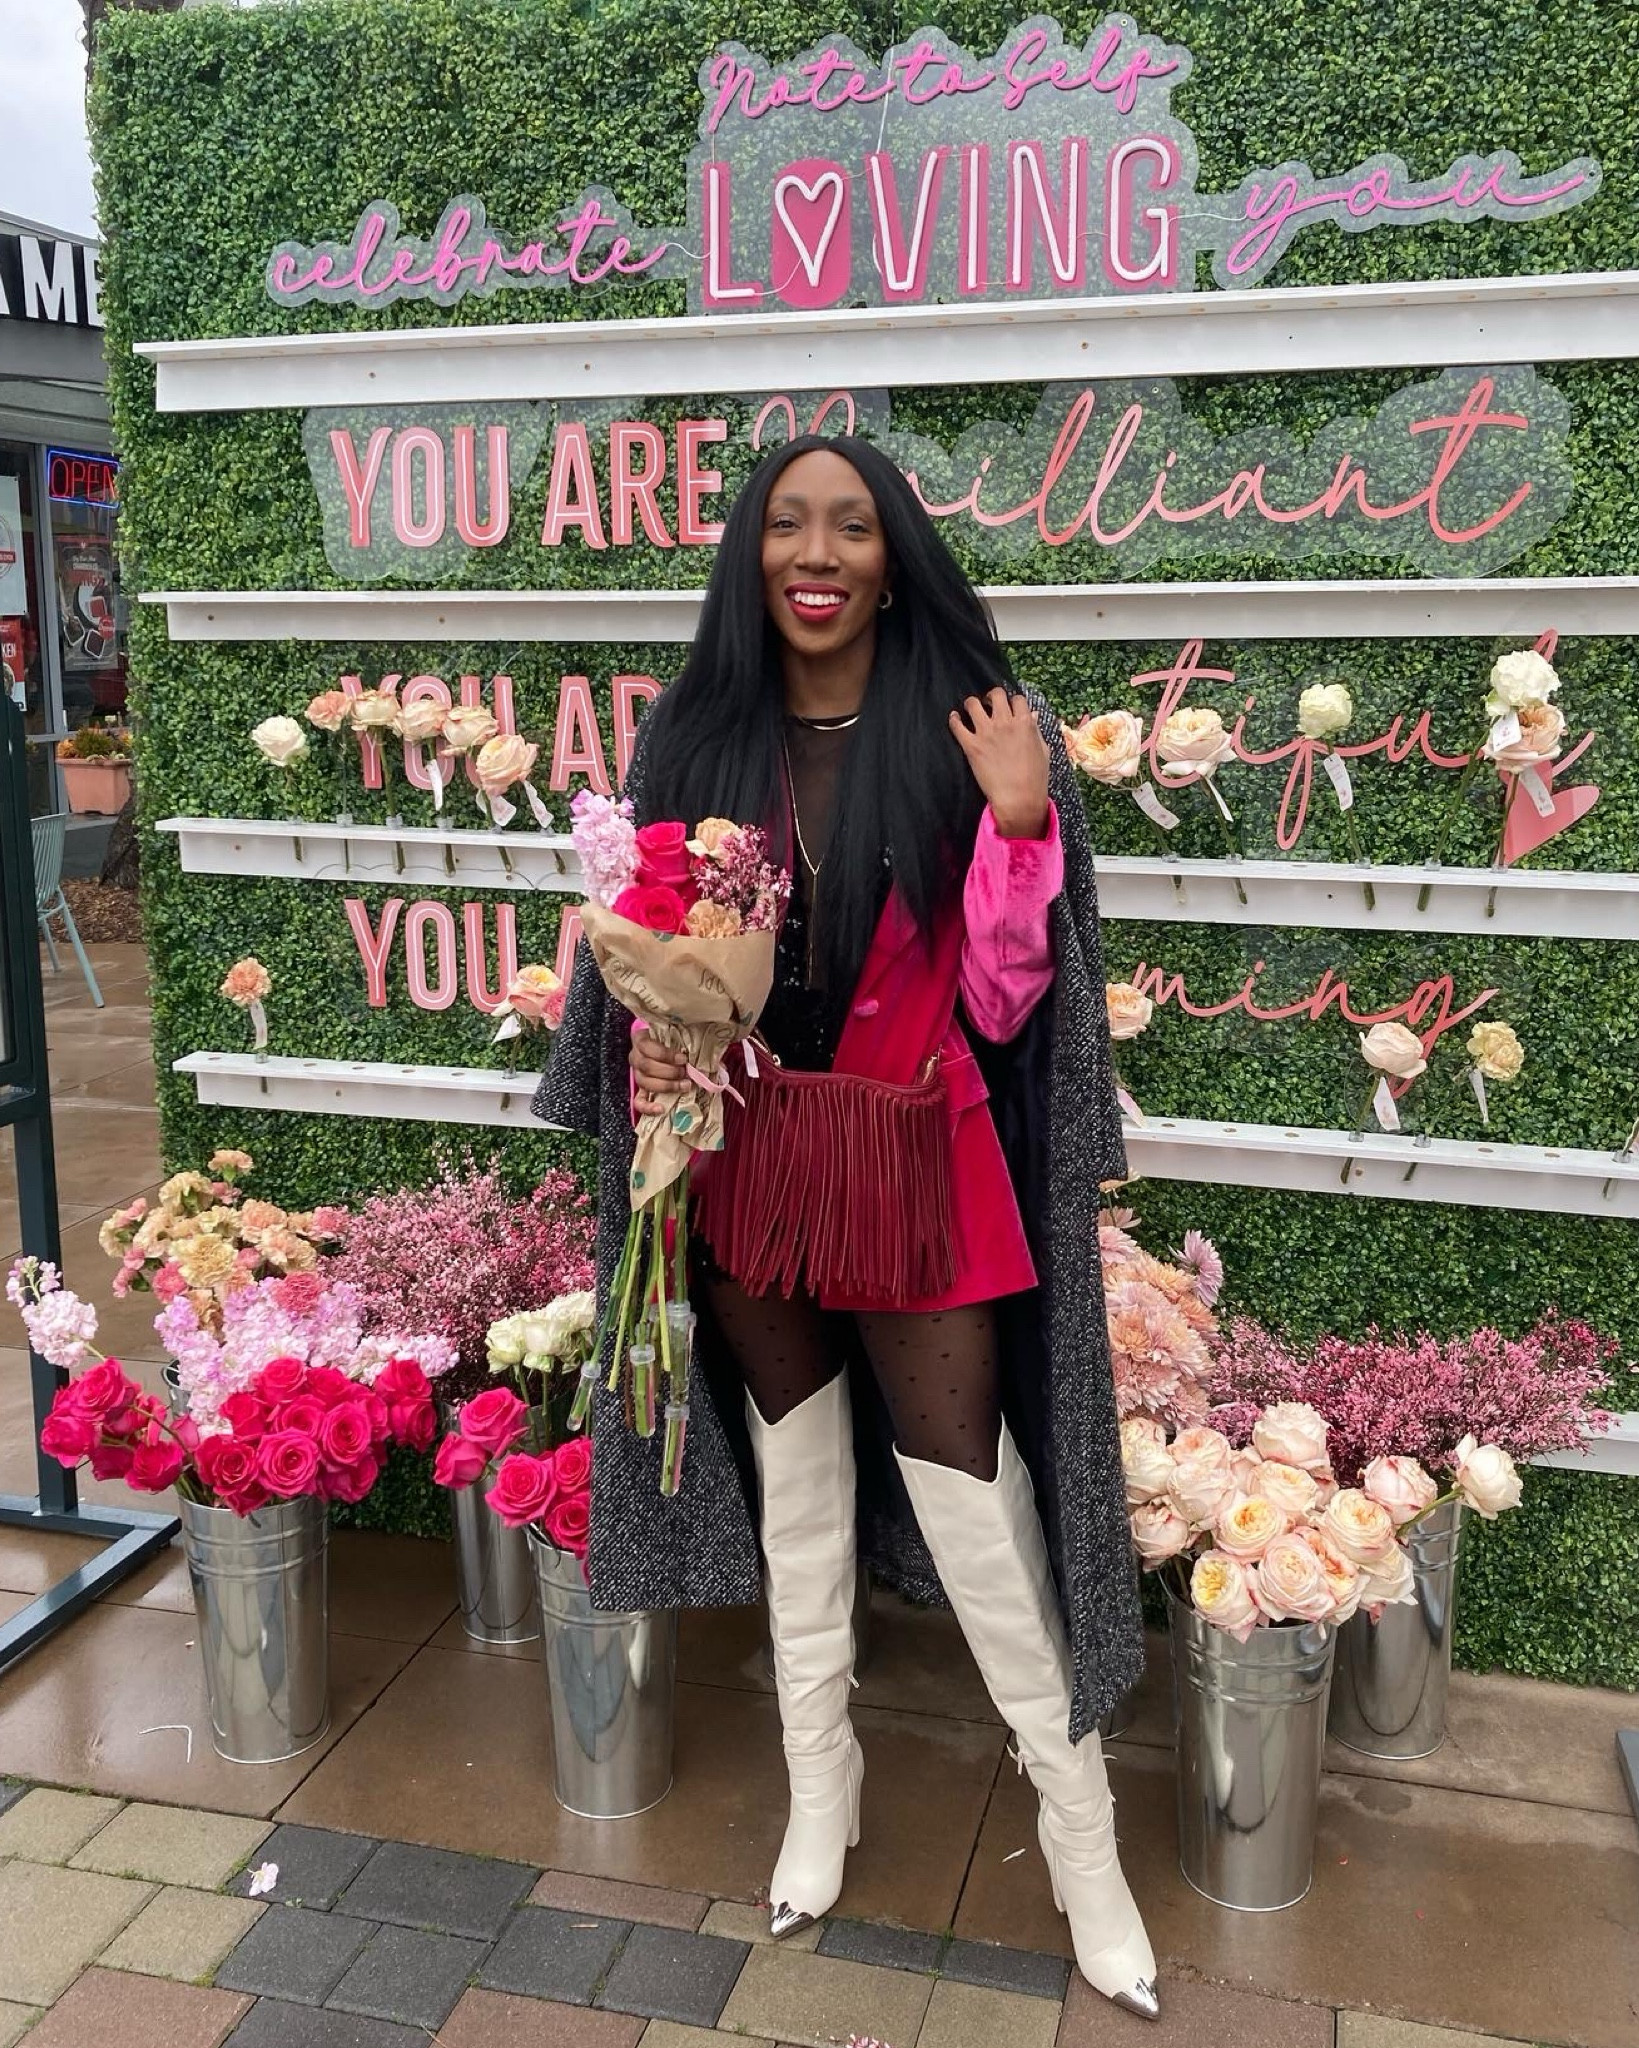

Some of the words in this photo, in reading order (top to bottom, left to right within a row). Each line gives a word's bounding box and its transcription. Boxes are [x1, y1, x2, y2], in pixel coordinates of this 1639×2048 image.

[707, 49, 896, 134] Note
[895, 41, 996, 105] to
[1003, 27, 1180, 115] Self
[271, 200, 669, 296] celebrate
[1226, 164, 1587, 275] you
[330, 425, 511, 547] YOU
[541, 419, 727, 549] ARE
[344, 898, 517, 1013] YOU
